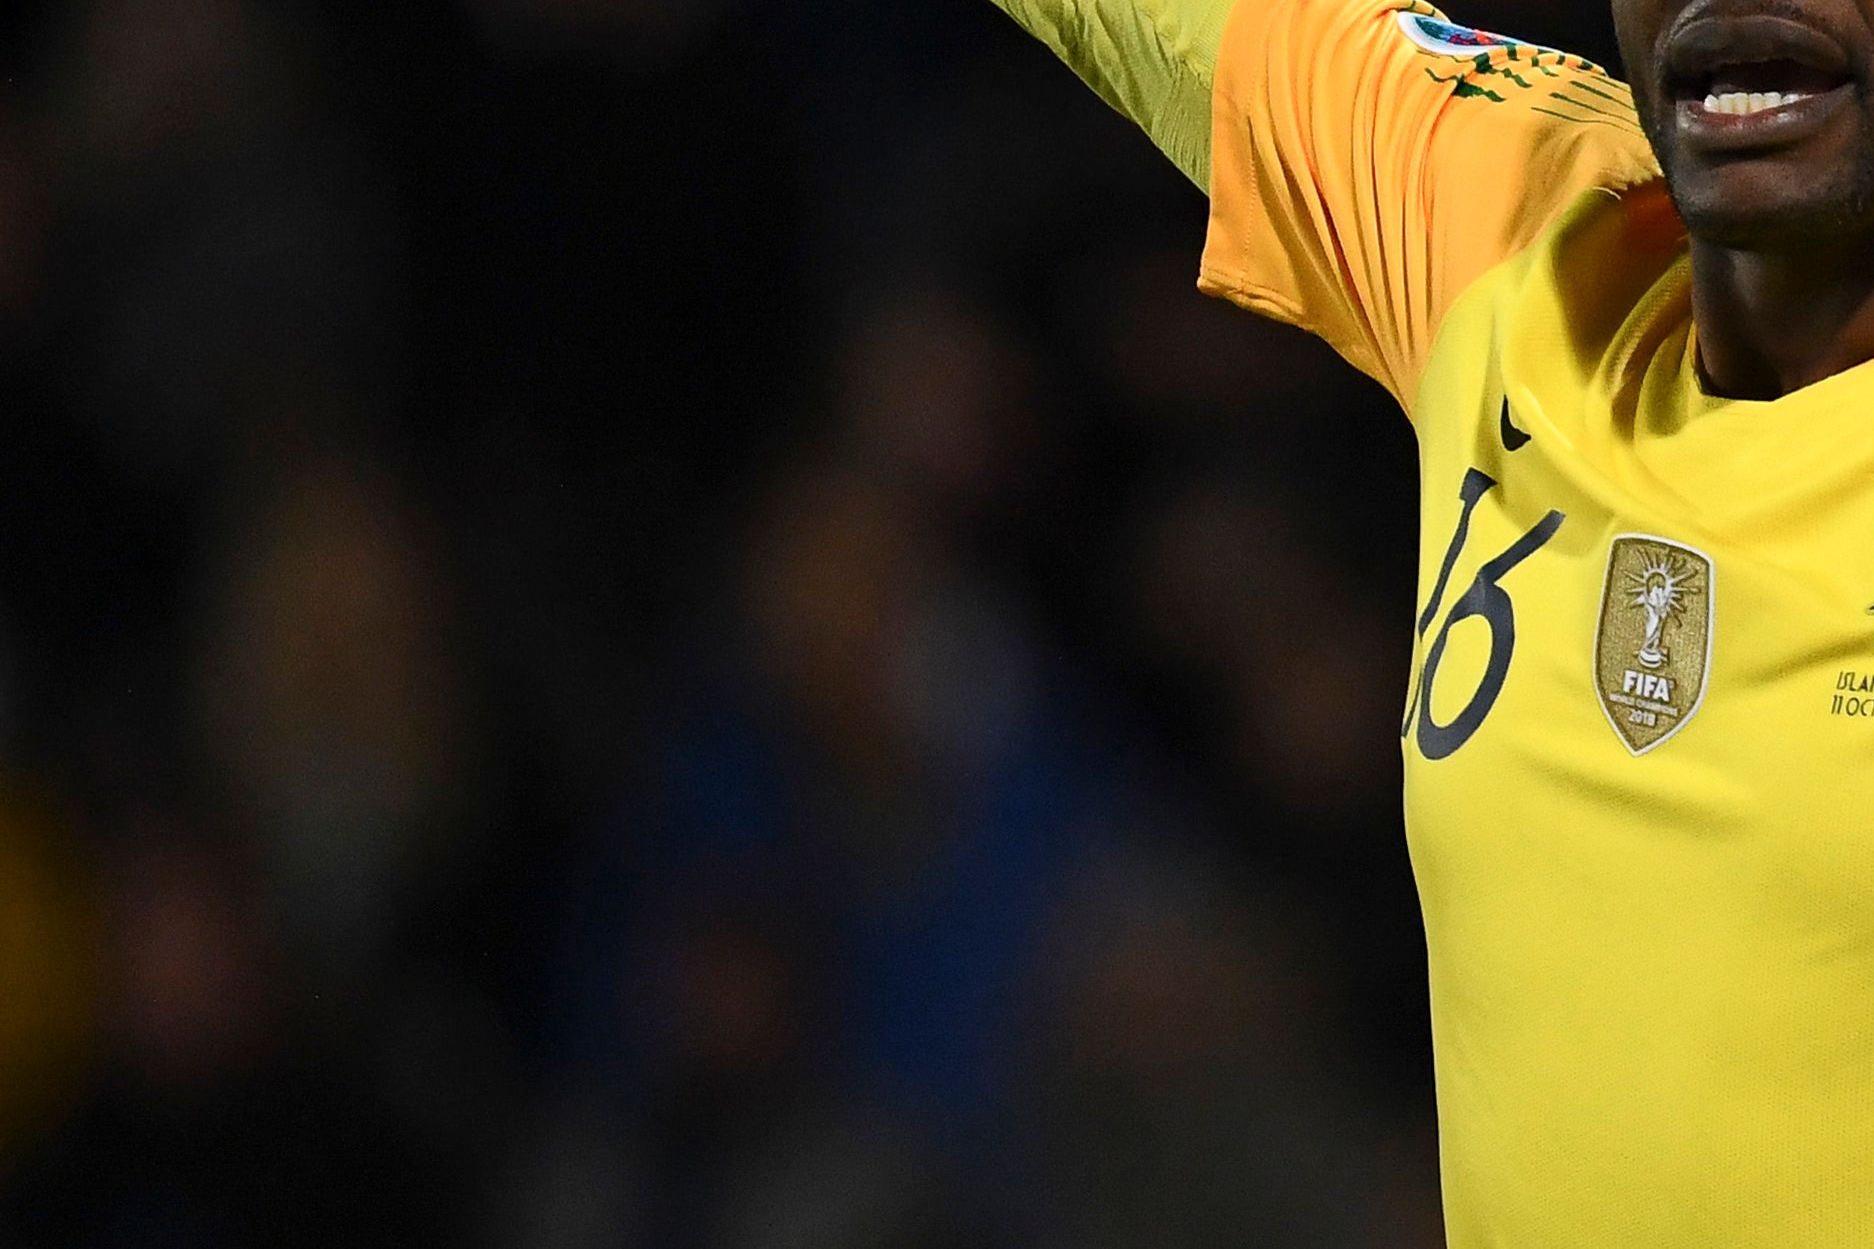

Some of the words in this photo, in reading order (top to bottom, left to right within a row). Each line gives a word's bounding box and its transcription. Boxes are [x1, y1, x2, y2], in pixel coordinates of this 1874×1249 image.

[1401, 467, 1566, 760] 16
[1623, 670, 1670, 702] FIFA
[1831, 694, 1844, 715] 11
